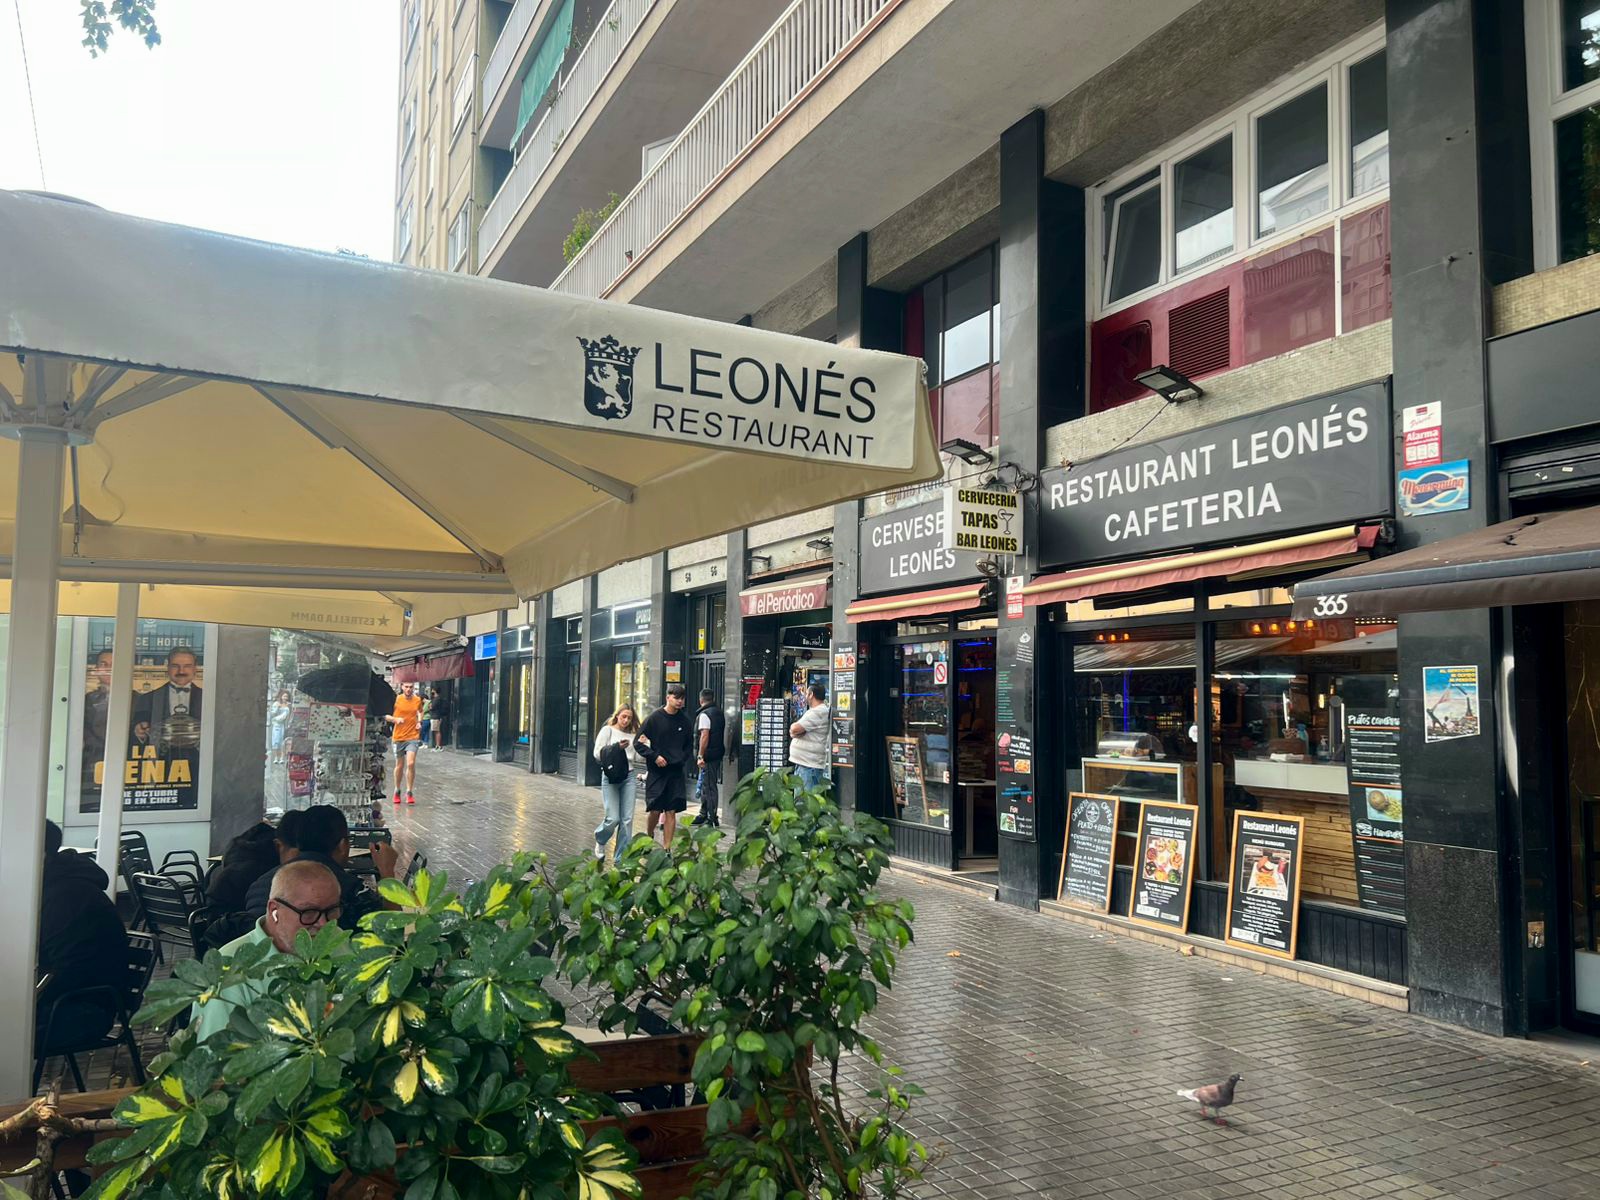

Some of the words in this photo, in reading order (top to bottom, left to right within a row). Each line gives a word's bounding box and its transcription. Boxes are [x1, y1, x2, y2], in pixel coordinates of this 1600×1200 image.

[655, 342, 876, 424] LEONÉS
[652, 403, 874, 459] RESTAURANT
[1406, 429, 1439, 442] Alarma
[1051, 443, 1216, 511] RESTAURANT
[1229, 403, 1369, 468] LEONÉS
[958, 489, 1017, 508] CERVECERIA
[961, 511, 998, 529] TAPAS
[1104, 482, 1283, 542] CAFETERIA
[872, 511, 944, 548] CERVESE
[956, 533, 978, 548] BAR
[980, 537, 1017, 552] LEONES
[889, 541, 956, 578] LEONÉS
[757, 594, 766, 614] el
[766, 588, 815, 613] Periódico
[1313, 594, 1348, 617] 365
[157, 637, 192, 647] HOTEL
[132, 745, 157, 759] LA
[135, 789, 178, 797] OCTUBRE
[150, 796, 178, 804] CINES
[1243, 820, 1275, 833] Restaurant
[1275, 823, 1297, 836] Leonés
